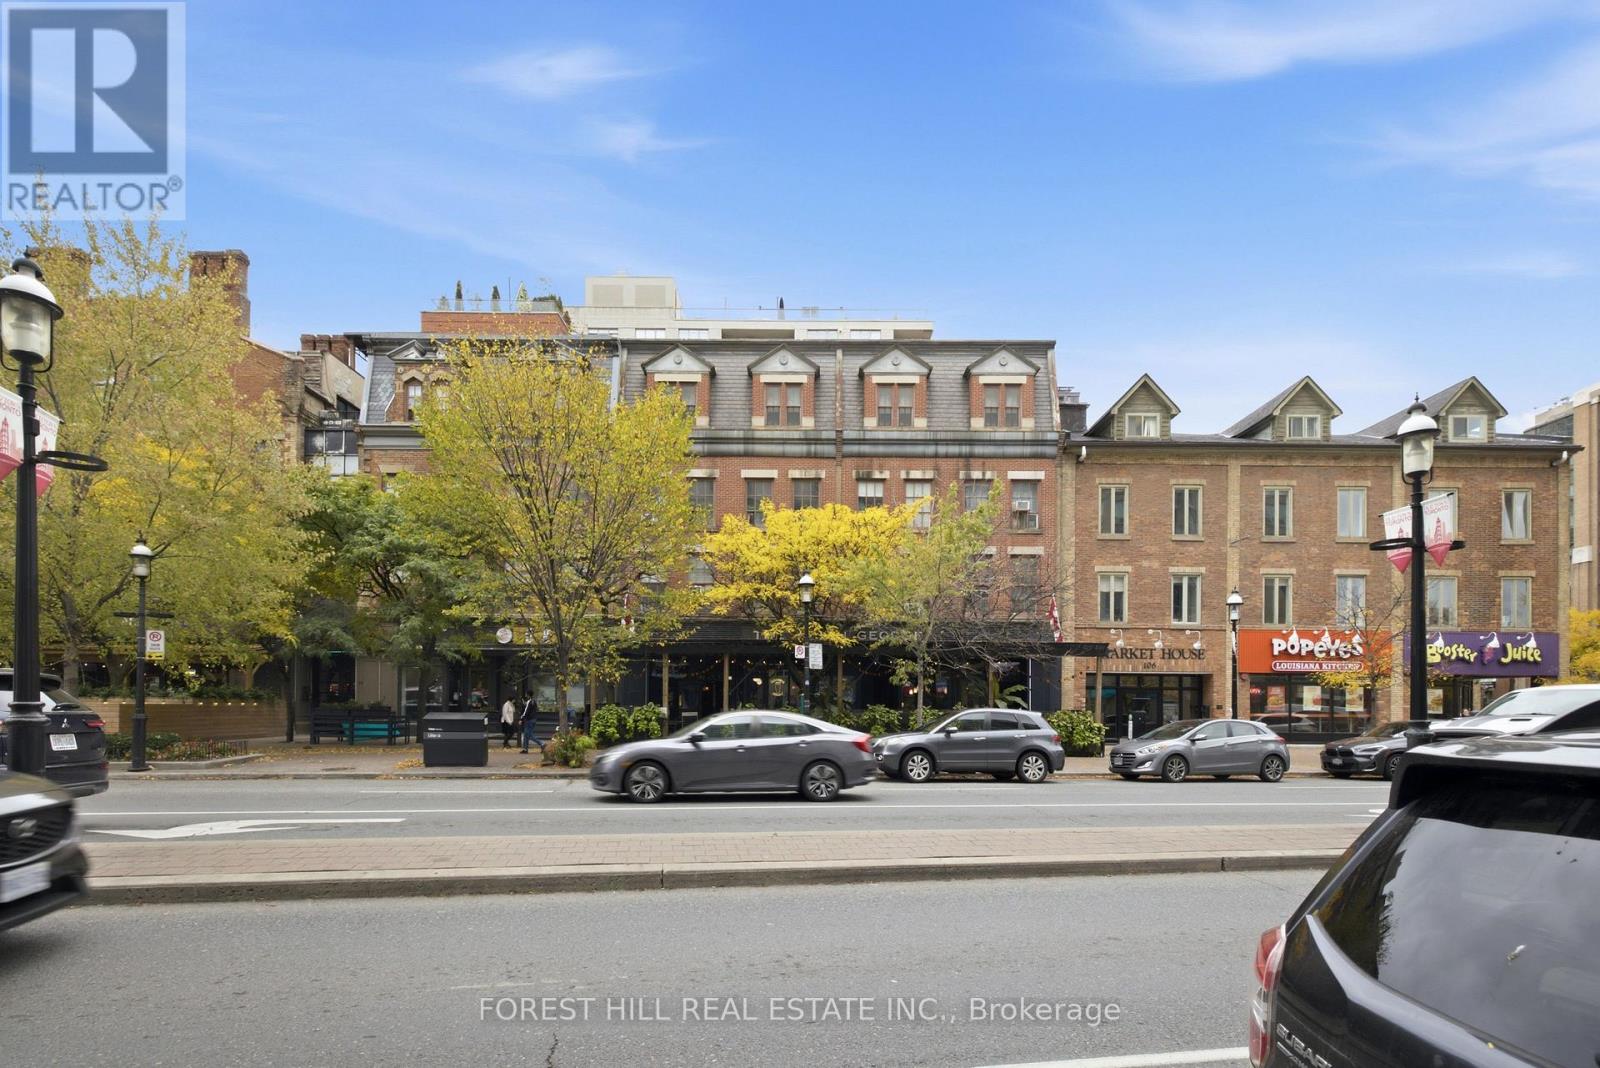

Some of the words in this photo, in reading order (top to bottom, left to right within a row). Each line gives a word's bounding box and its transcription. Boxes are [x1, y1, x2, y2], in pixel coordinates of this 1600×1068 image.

[1104, 647, 1156, 660] ARKET
[1161, 648, 1206, 660] HOUSE
[1426, 643, 1478, 663] Booster
[1501, 642, 1542, 663] Juice
[1276, 662, 1320, 670] LOUISIANA
